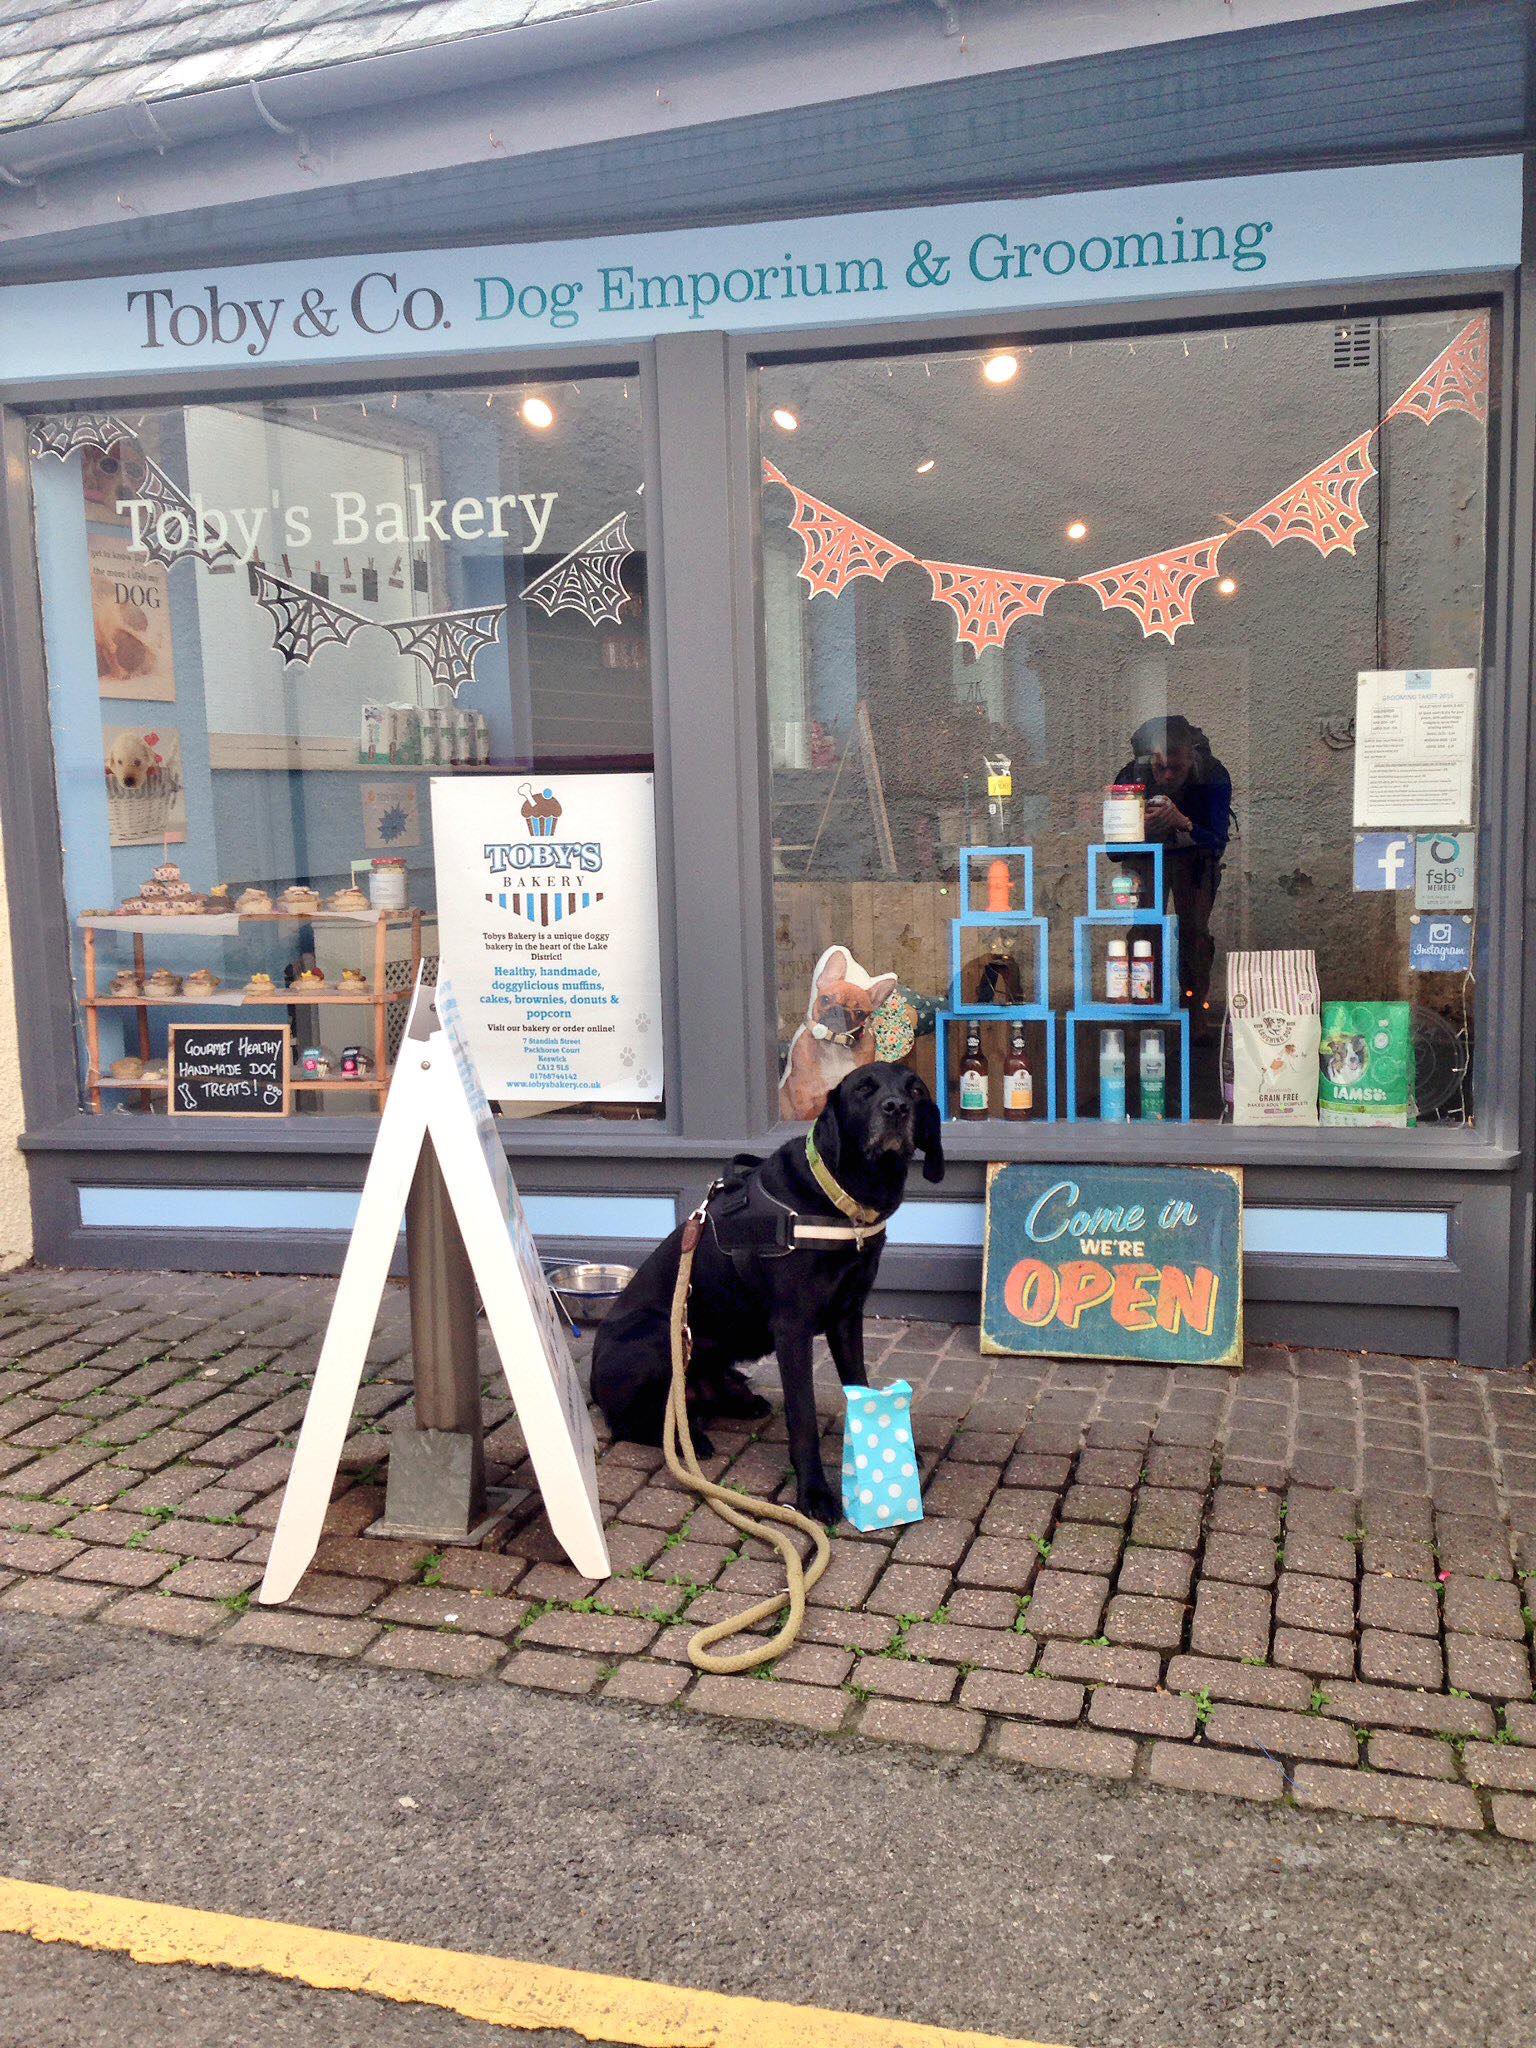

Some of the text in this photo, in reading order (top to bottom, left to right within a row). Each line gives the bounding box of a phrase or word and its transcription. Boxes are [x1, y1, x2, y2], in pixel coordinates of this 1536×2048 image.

[127, 216, 1274, 356] Toby & Co. Dog Emporium & Grooming
[115, 483, 559, 566] Toby's Bakery
[114, 582, 160, 609] DOG
[483, 842, 603, 874] TOBY'S
[502, 876, 585, 888] BAKERY
[1425, 869, 1457, 884] fsb
[1427, 884, 1456, 892] MEMBER
[482, 932, 506, 942] Tobys
[508, 932, 536, 942] Bakery
[538, 932, 545, 940] is
[554, 932, 583, 942] unique
[584, 931, 610, 942] doggy
[485, 943, 514, 952] bakery
[1413, 943, 1465, 961] Instagram
[531, 952, 563, 961] District!
[494, 966, 601, 978] Healthy, handmade,
[491, 980, 605, 993] doggylicious muffins,
[480, 994, 620, 1005] cakes, brownies, donuts &
[526, 1010, 572, 1020] popcorn
[487, 1023, 505, 1032] Visit
[522, 1024, 551, 1034] bakery
[562, 1024, 585, 1032] order
[586, 1025, 616, 1033] online!
[528, 1037, 559, 1045] Standish
[559, 1037, 581, 1045] Street
[523, 1046, 580, 1054] Packhorse Court
[538, 1055, 567, 1063] Keswick
[178, 1062, 277, 1079] HANDMADE DOG
[506, 1080, 602, 1090] www.tobysbakery.co.uk
[1259, 1092, 1300, 1102] GRAIN FREE
[1333, 1086, 1373, 1101] IAMS
[1023, 1180, 1198, 1243] Come in
[1080, 1238, 1146, 1258] WE'RE
[1004, 1258, 1220, 1336] OPEN
